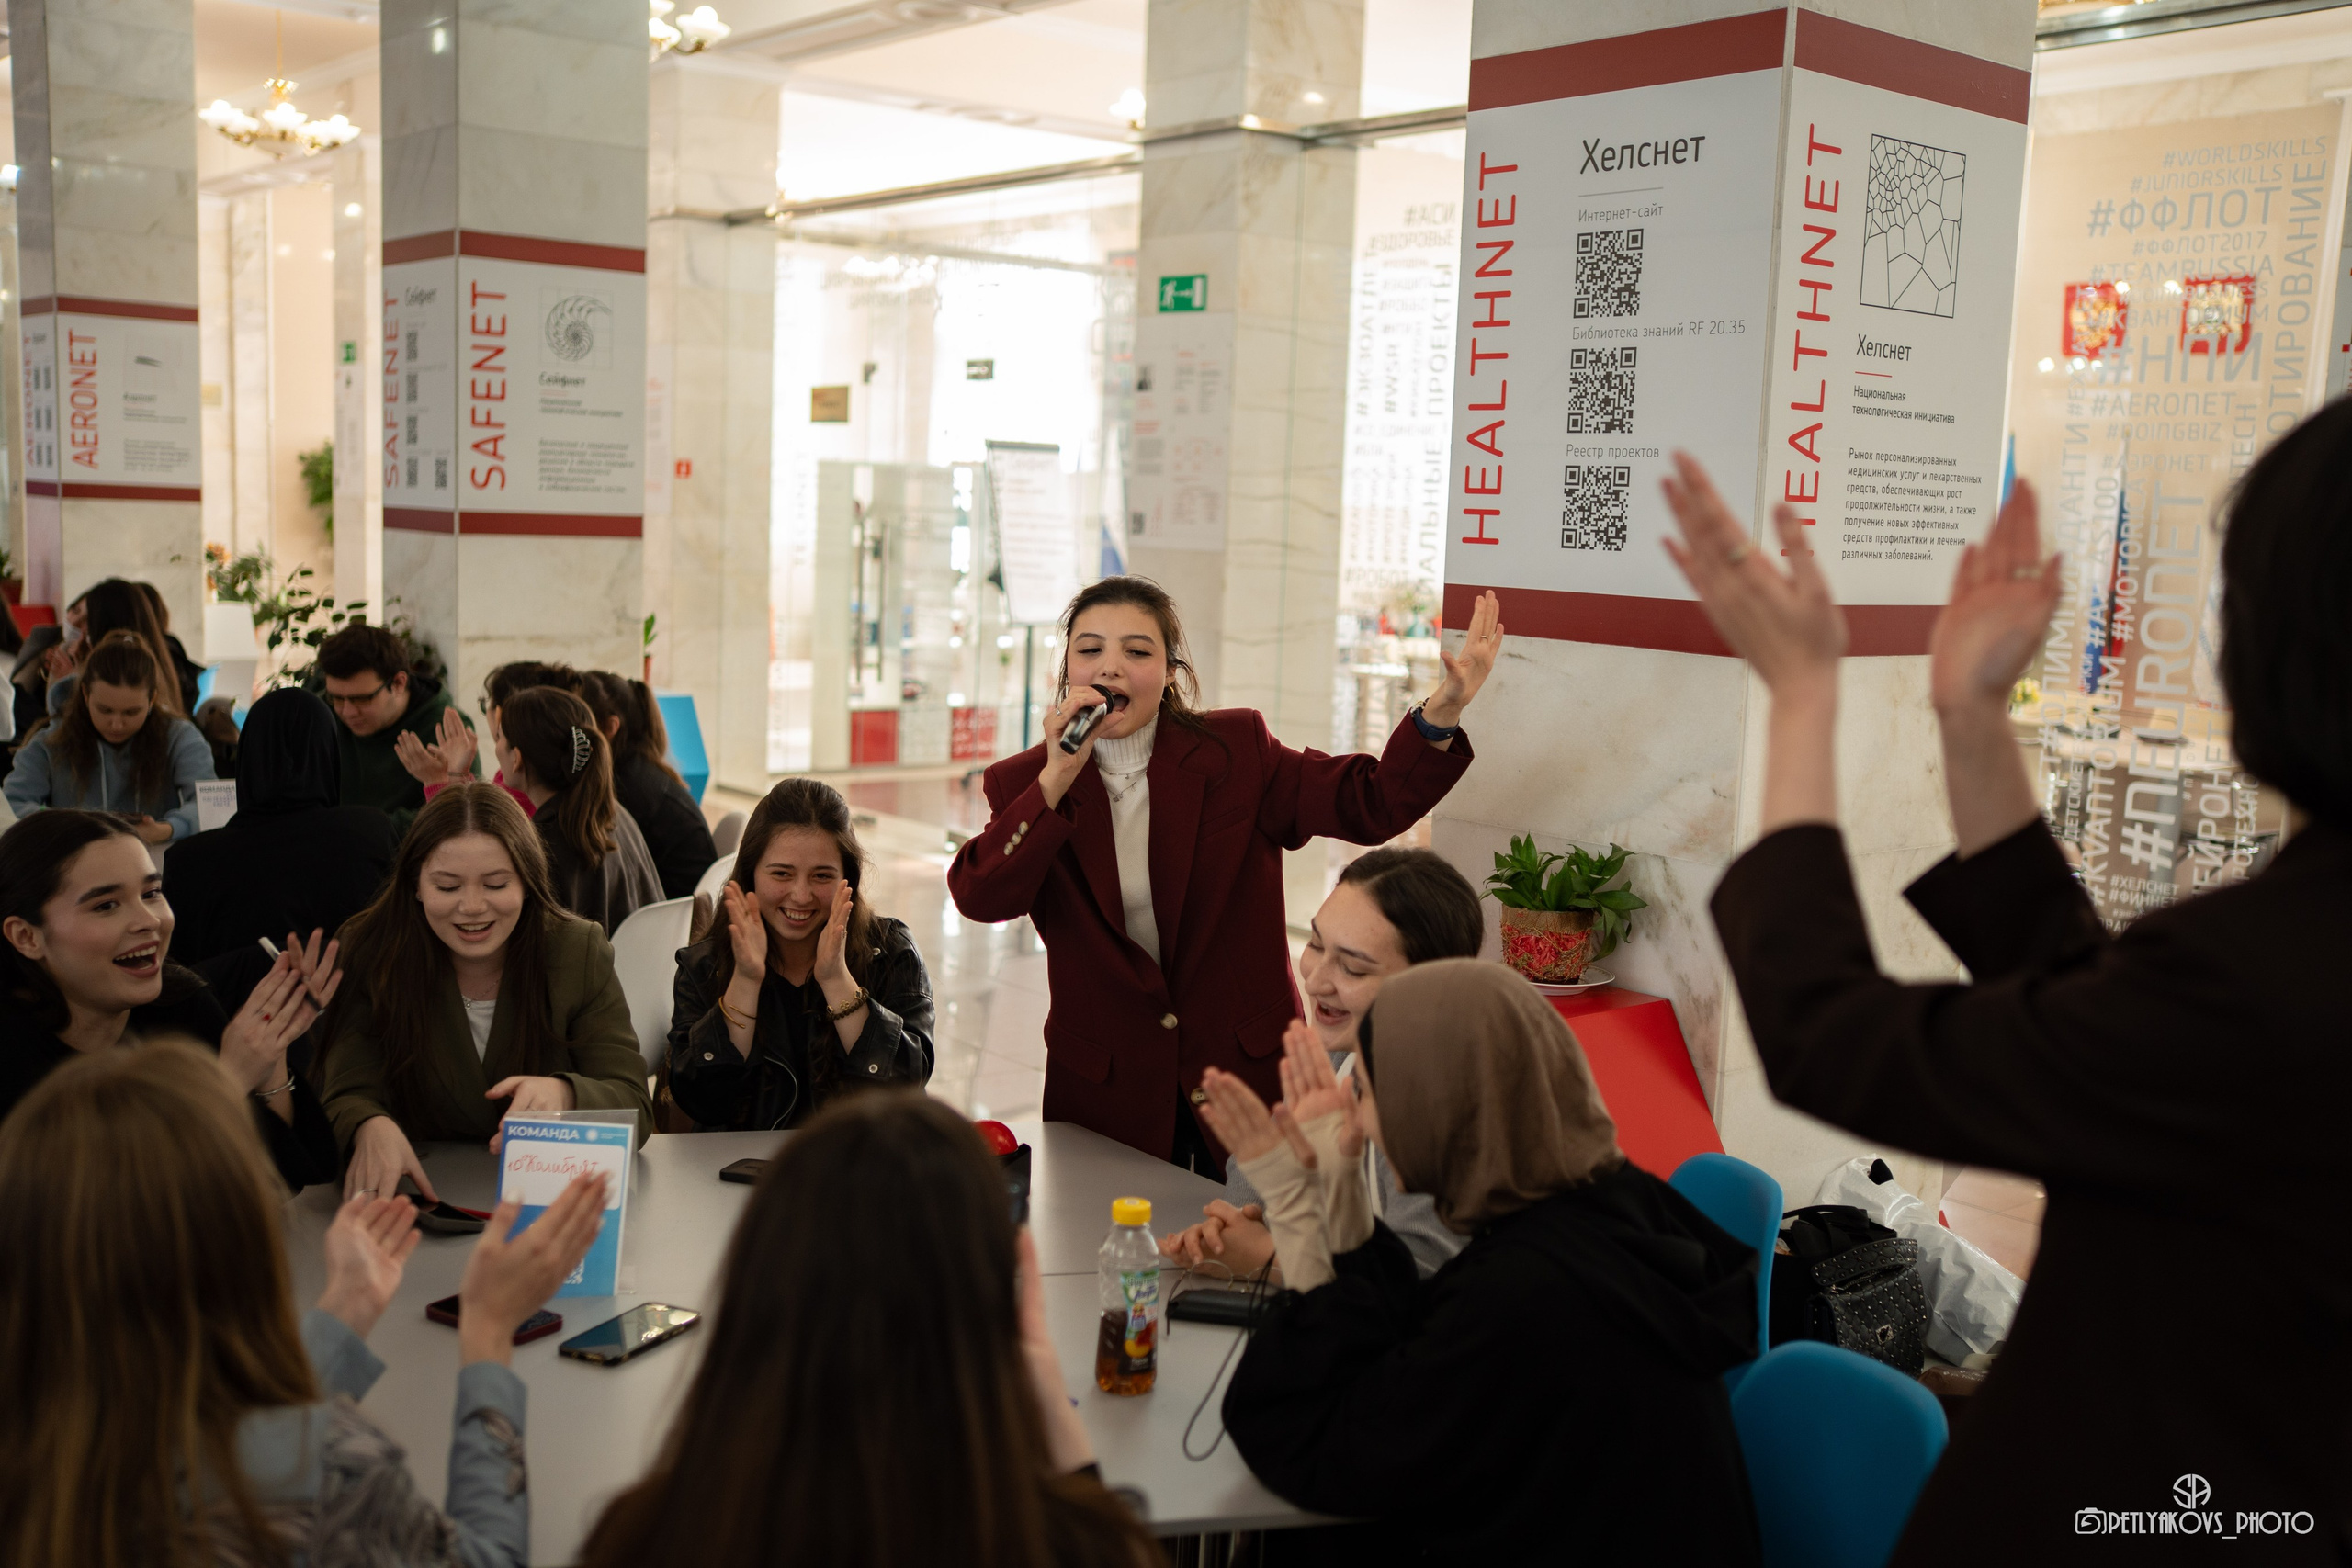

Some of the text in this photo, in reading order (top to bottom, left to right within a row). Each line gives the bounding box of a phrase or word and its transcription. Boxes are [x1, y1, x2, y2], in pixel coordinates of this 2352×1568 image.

[1579, 135, 1706, 175] Хелснет
[2163, 135, 2326, 169] #WORLDSKILLS
[1578, 203, 1664, 223] Интернет-сайт
[2087, 186, 2283, 238] #ФФЛОТ
[2132, 231, 2267, 257] #ФФЛОТ2017
[2089, 254, 2274, 287] #TEAMRUSSIA
[2265, 159, 2327, 443] ОТИРОВАНИЕ
[1572, 319, 1746, 340] Библиотека знаний RF 20.35
[1462, 152, 1518, 545] HEALTHNET
[1856, 333, 1912, 362] Хелснет
[470, 279, 507, 491] SAFENET
[1853, 385, 1906, 401] Национальная
[68, 328, 99, 470] AERONET
[1914, 412, 1955, 423] инициатива
[1566, 443, 1659, 460] Реестр проектов
[2227, 403, 2257, 482] TECH
[1849, 447, 1957, 467] Рынок персонализированных
[1848, 467, 1898, 479] медицинских
[1900, 470, 1920, 481] услуг
[1928, 472, 1982, 484] лекарственных
[1847, 483, 1962, 500] средств, обеспечивающих рост
[1845, 500, 1976, 515] продолжительности жизни, а также
[1844, 516, 1959, 531] получение новых эффективных
[1842, 533, 1966, 546] средств профилактики и лечения
[1841, 548, 1933, 561] различных заболеваний.
[2110, 478, 2145, 643] #MOTORICA
[2110, 874, 2179, 896] #ХЕЛСНЕТ
[507, 1125, 580, 1141] КОМАНДА
